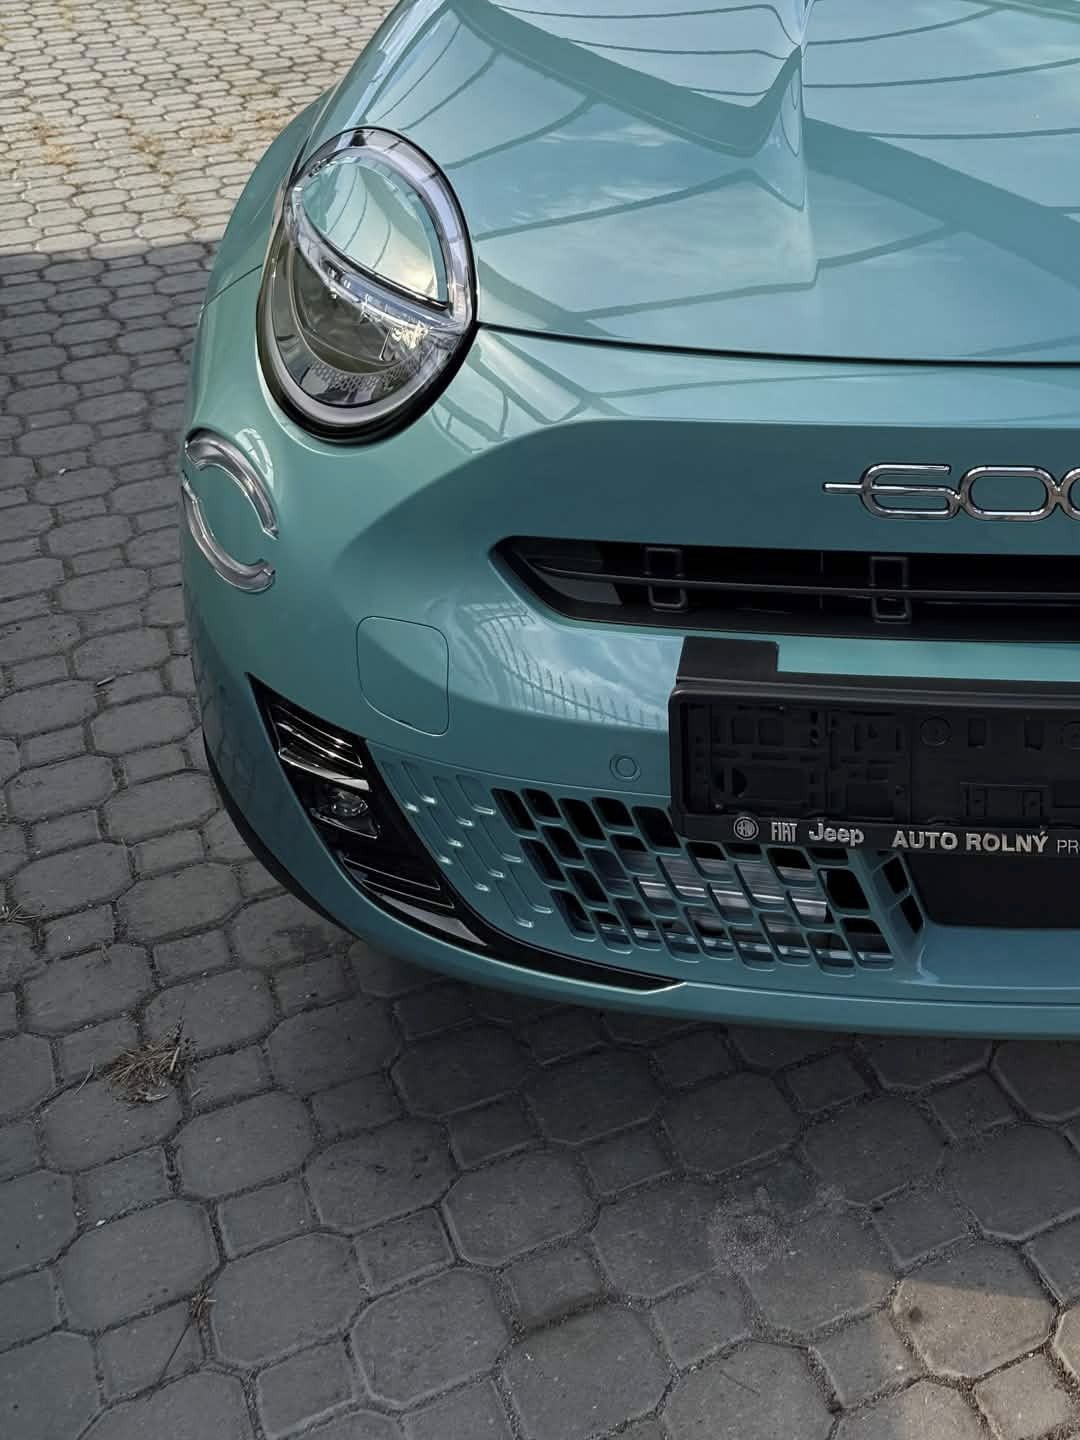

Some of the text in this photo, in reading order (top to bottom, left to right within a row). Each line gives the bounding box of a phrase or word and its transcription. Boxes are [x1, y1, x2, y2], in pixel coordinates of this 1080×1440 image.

[771, 822, 797, 842] FIAT
[809, 822, 865, 846] Jeep
[892, 830, 958, 849] AUTO
[966, 830, 1049, 852] ROLNÝ
